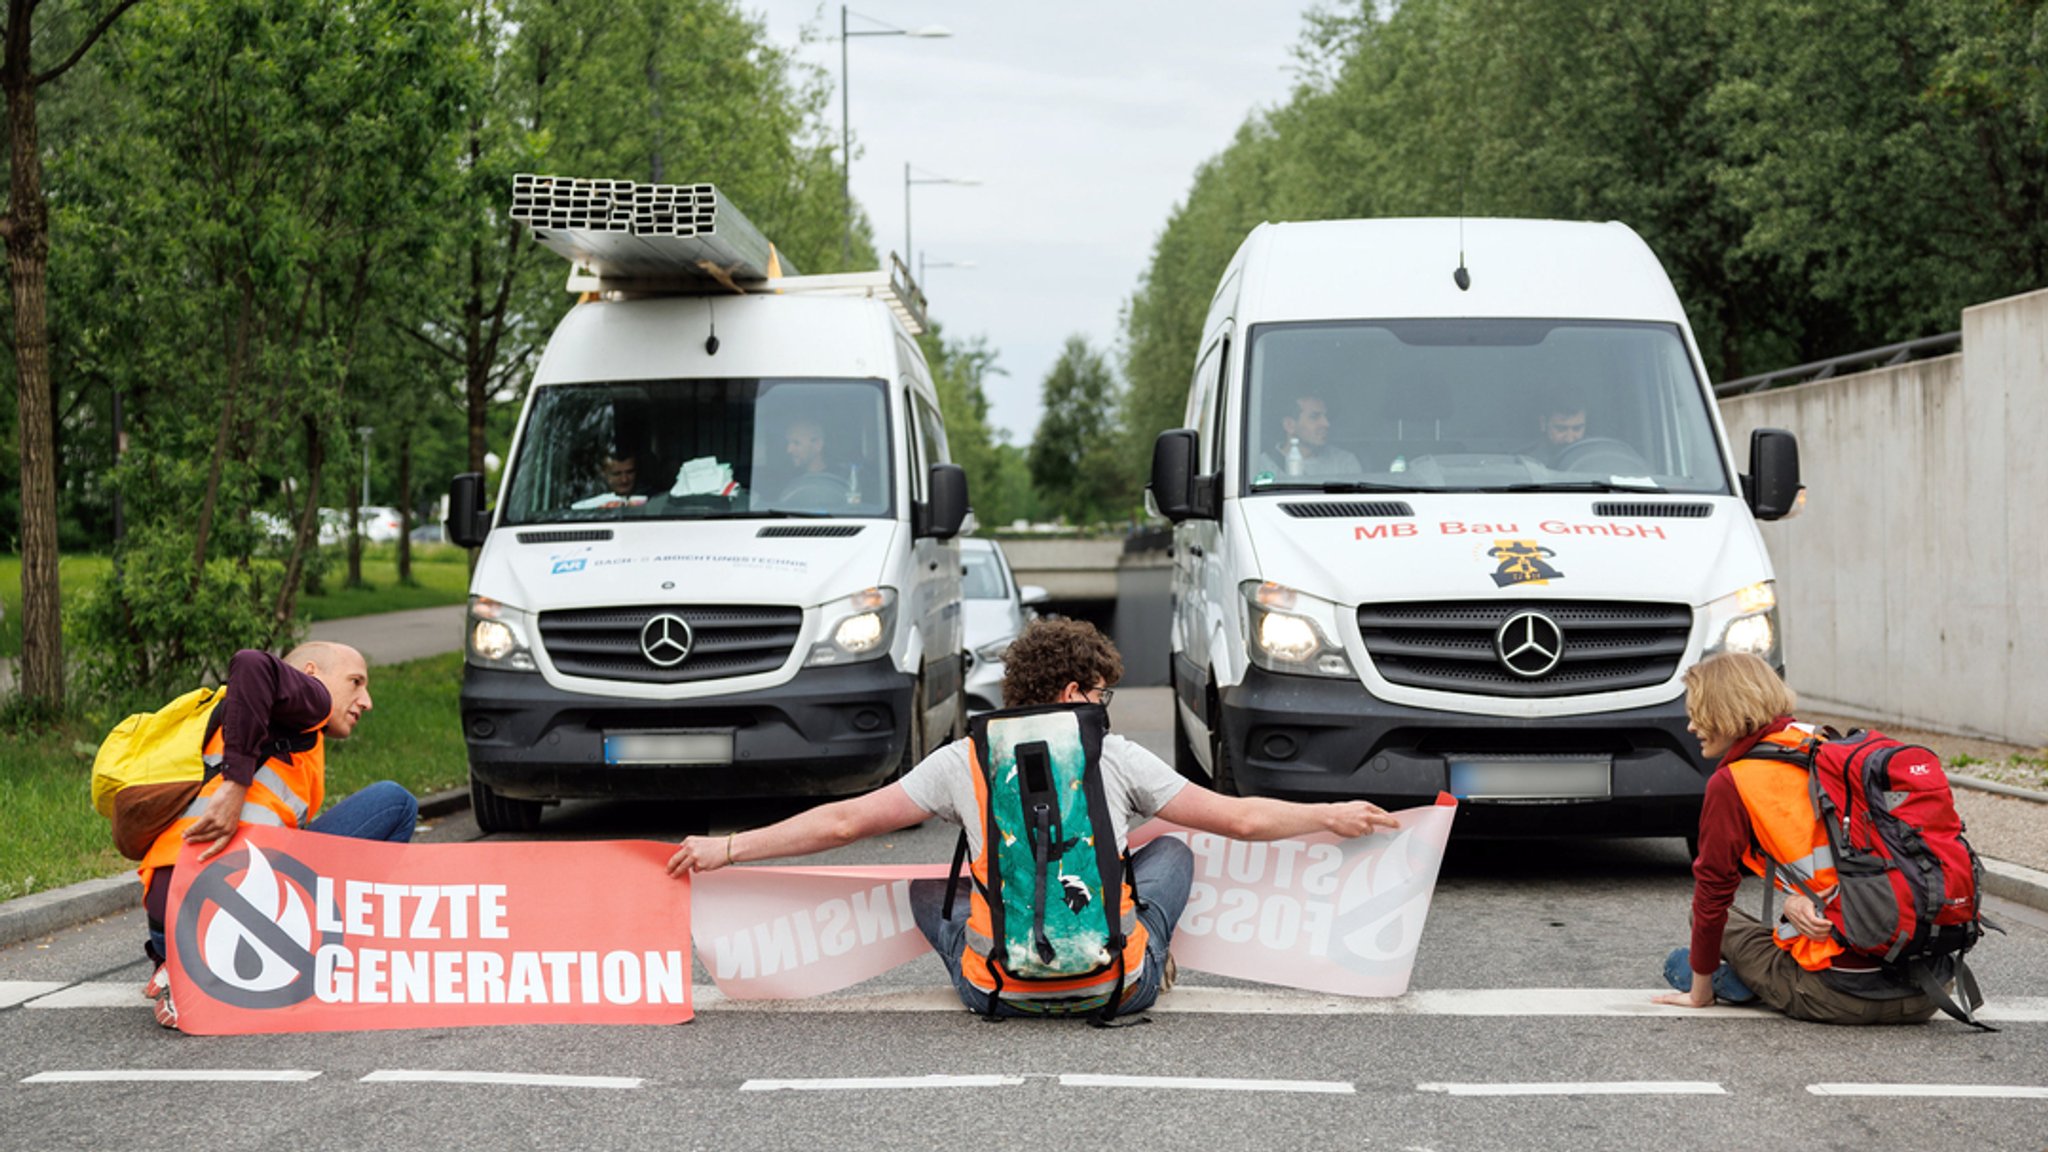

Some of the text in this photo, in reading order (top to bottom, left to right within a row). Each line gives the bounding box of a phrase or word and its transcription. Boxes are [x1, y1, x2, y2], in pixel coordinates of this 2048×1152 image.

[1354, 520, 1667, 540] MB Bau GmbH
[316, 876, 509, 939] LETZTE
[314, 944, 684, 1005] GENERATION
